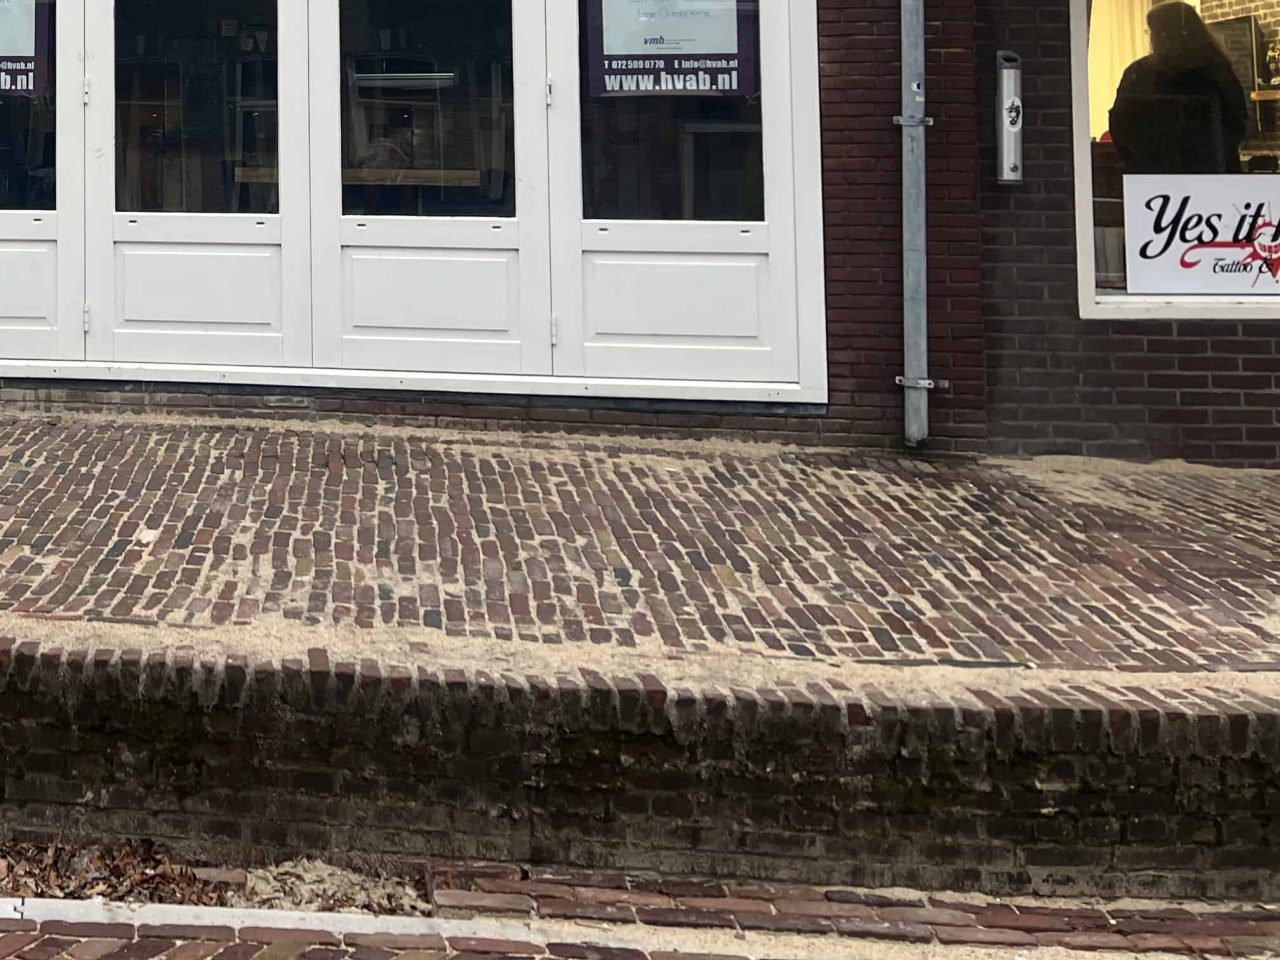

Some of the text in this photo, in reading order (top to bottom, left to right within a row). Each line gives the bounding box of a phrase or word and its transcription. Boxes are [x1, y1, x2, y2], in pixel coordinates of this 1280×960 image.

[644, 36, 665, 45] vmh
[604, 71, 738, 90] www.hvab.nl
[1139, 194, 1224, 260] Yes
[1232, 202, 1265, 244] it
[1212, 258, 1253, 274] Tattoo
